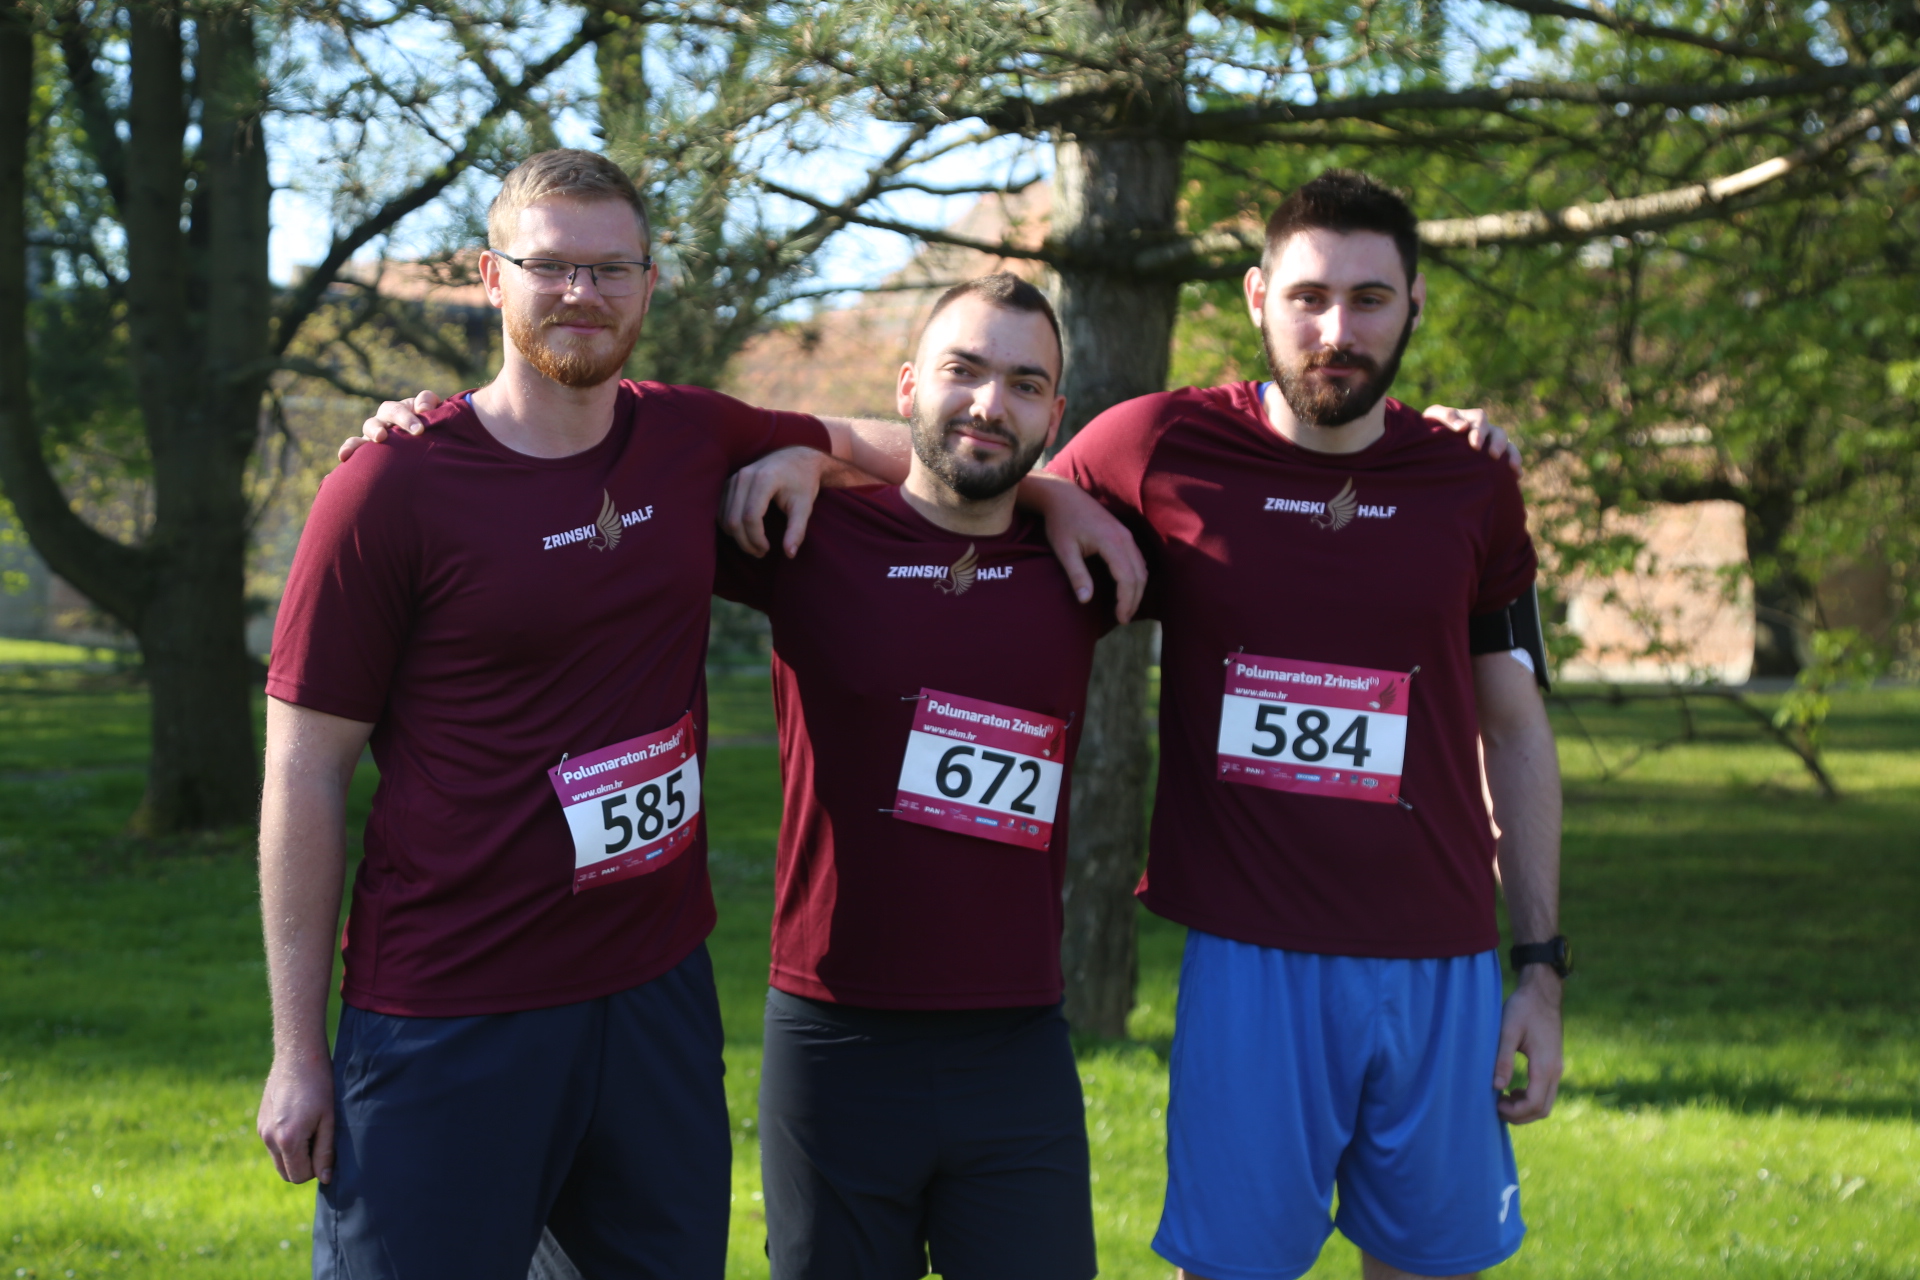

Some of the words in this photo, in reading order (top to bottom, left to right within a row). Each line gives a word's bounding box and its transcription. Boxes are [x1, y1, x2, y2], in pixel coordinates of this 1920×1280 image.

[543, 523, 597, 550] ZRINSKI
[621, 505, 654, 528] HALF
[1264, 497, 1326, 514] ZRINSKI
[1357, 504, 1397, 518] HALF
[887, 565, 949, 579] ZRINSKI
[977, 566, 1013, 580] HALF
[1234, 686, 1288, 701] www.akm.hr
[1235, 663, 1322, 686] Polumaraton
[1324, 673, 1370, 691] Zrinski
[927, 700, 1011, 729] Polumaraton
[1011, 718, 1048, 738] Zrinski
[1251, 703, 1372, 767] 584
[562, 749, 648, 784] Polumaraton
[648, 734, 680, 758] Zrinski
[935, 745, 1042, 815] 672
[601, 769, 685, 854] 585
